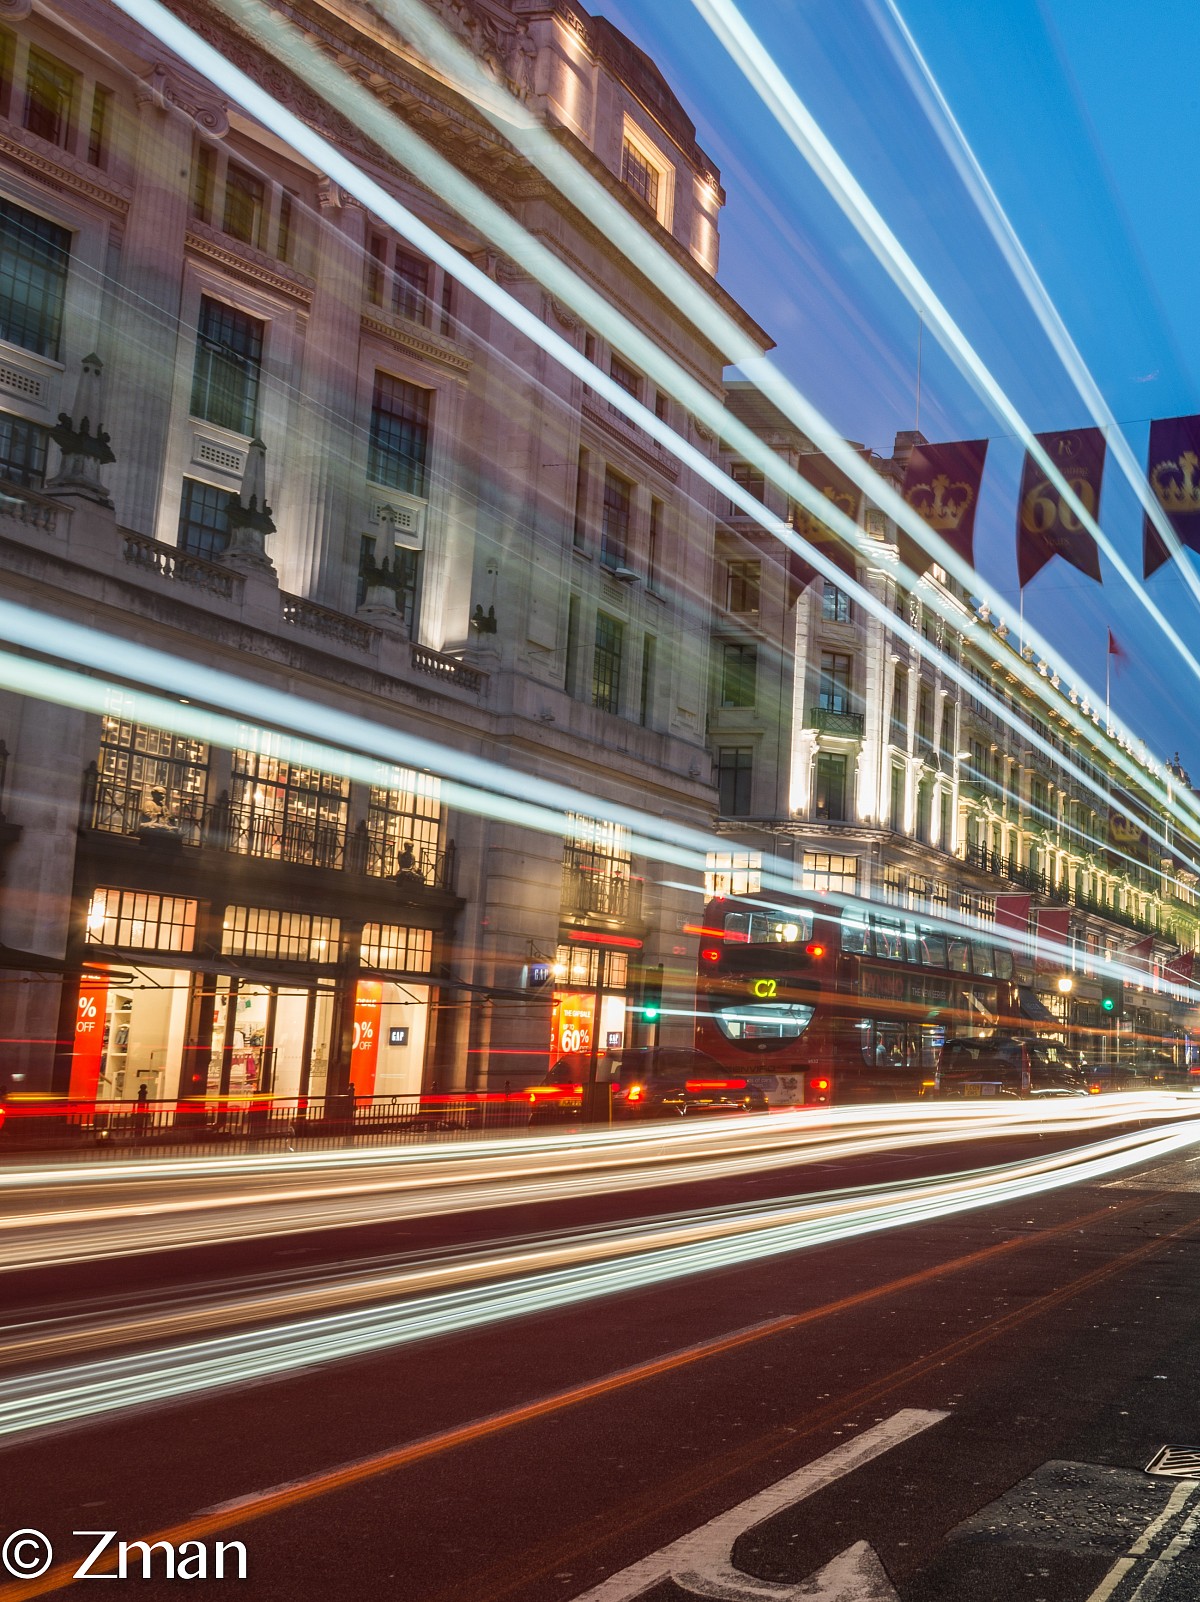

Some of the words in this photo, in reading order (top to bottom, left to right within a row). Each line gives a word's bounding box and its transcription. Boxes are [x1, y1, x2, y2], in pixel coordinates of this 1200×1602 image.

[1022, 478, 1095, 534] 60
[534, 968, 549, 981] GAP
[754, 979, 777, 998] C2
[563, 1009, 572, 1017] THE
[76, 1021, 96, 1033] OFF
[391, 1031, 405, 1042] GAP
[562, 1029, 590, 1053] 60%
[608, 1033, 619, 1042] GAP
[360, 1041, 373, 1051] OFF
